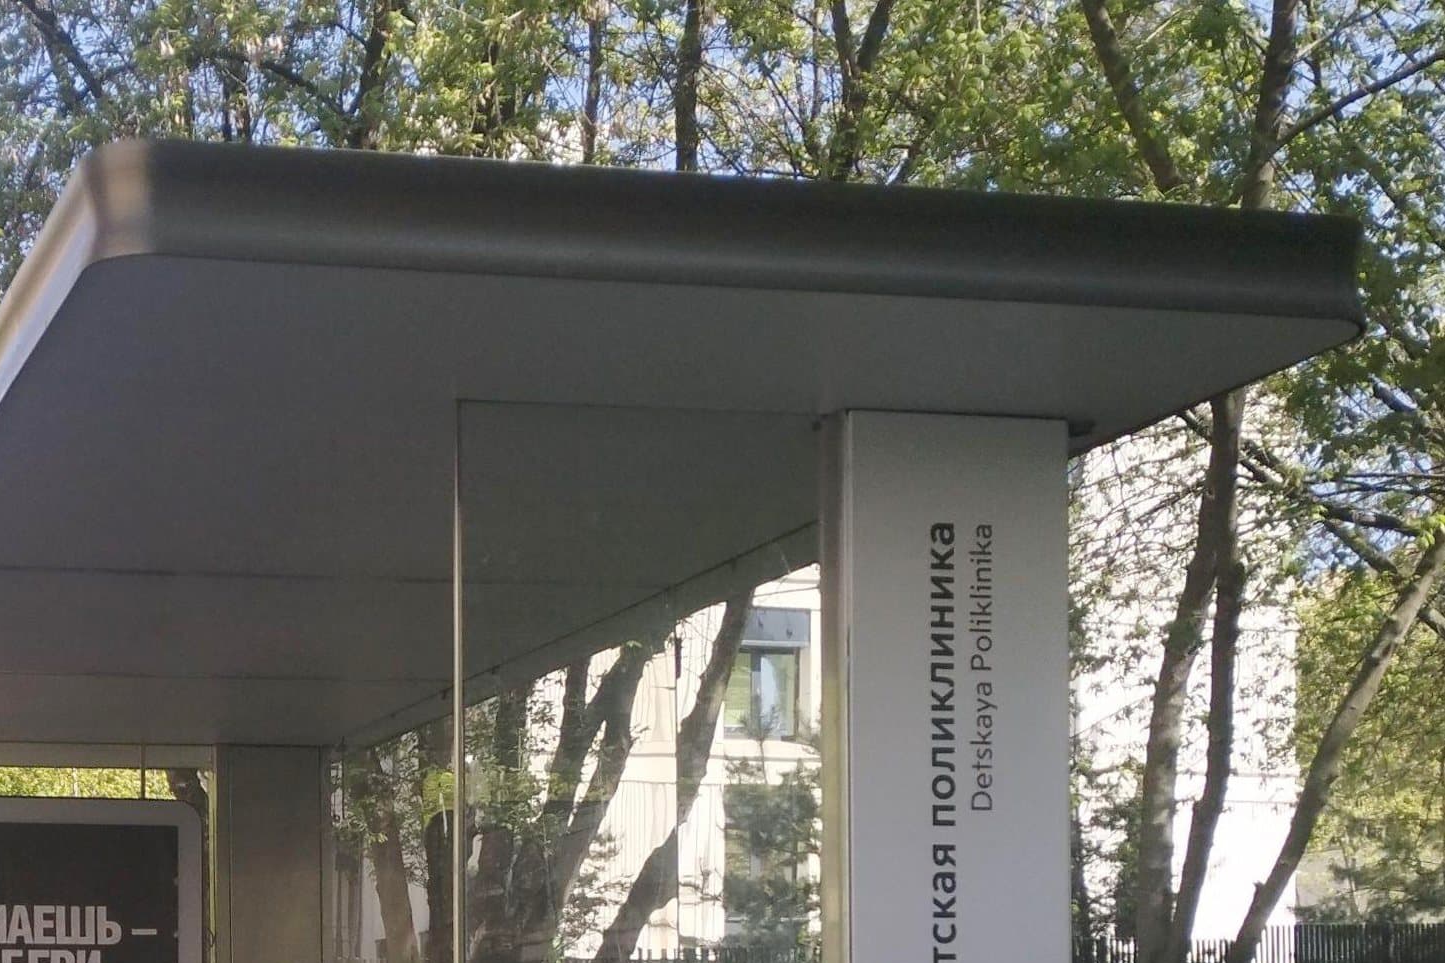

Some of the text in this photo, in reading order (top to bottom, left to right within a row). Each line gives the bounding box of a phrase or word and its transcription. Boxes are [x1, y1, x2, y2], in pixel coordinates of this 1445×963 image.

[930, 522, 956, 826] поликлиника
[969, 523, 997, 811] Detskaya Poliklinika
